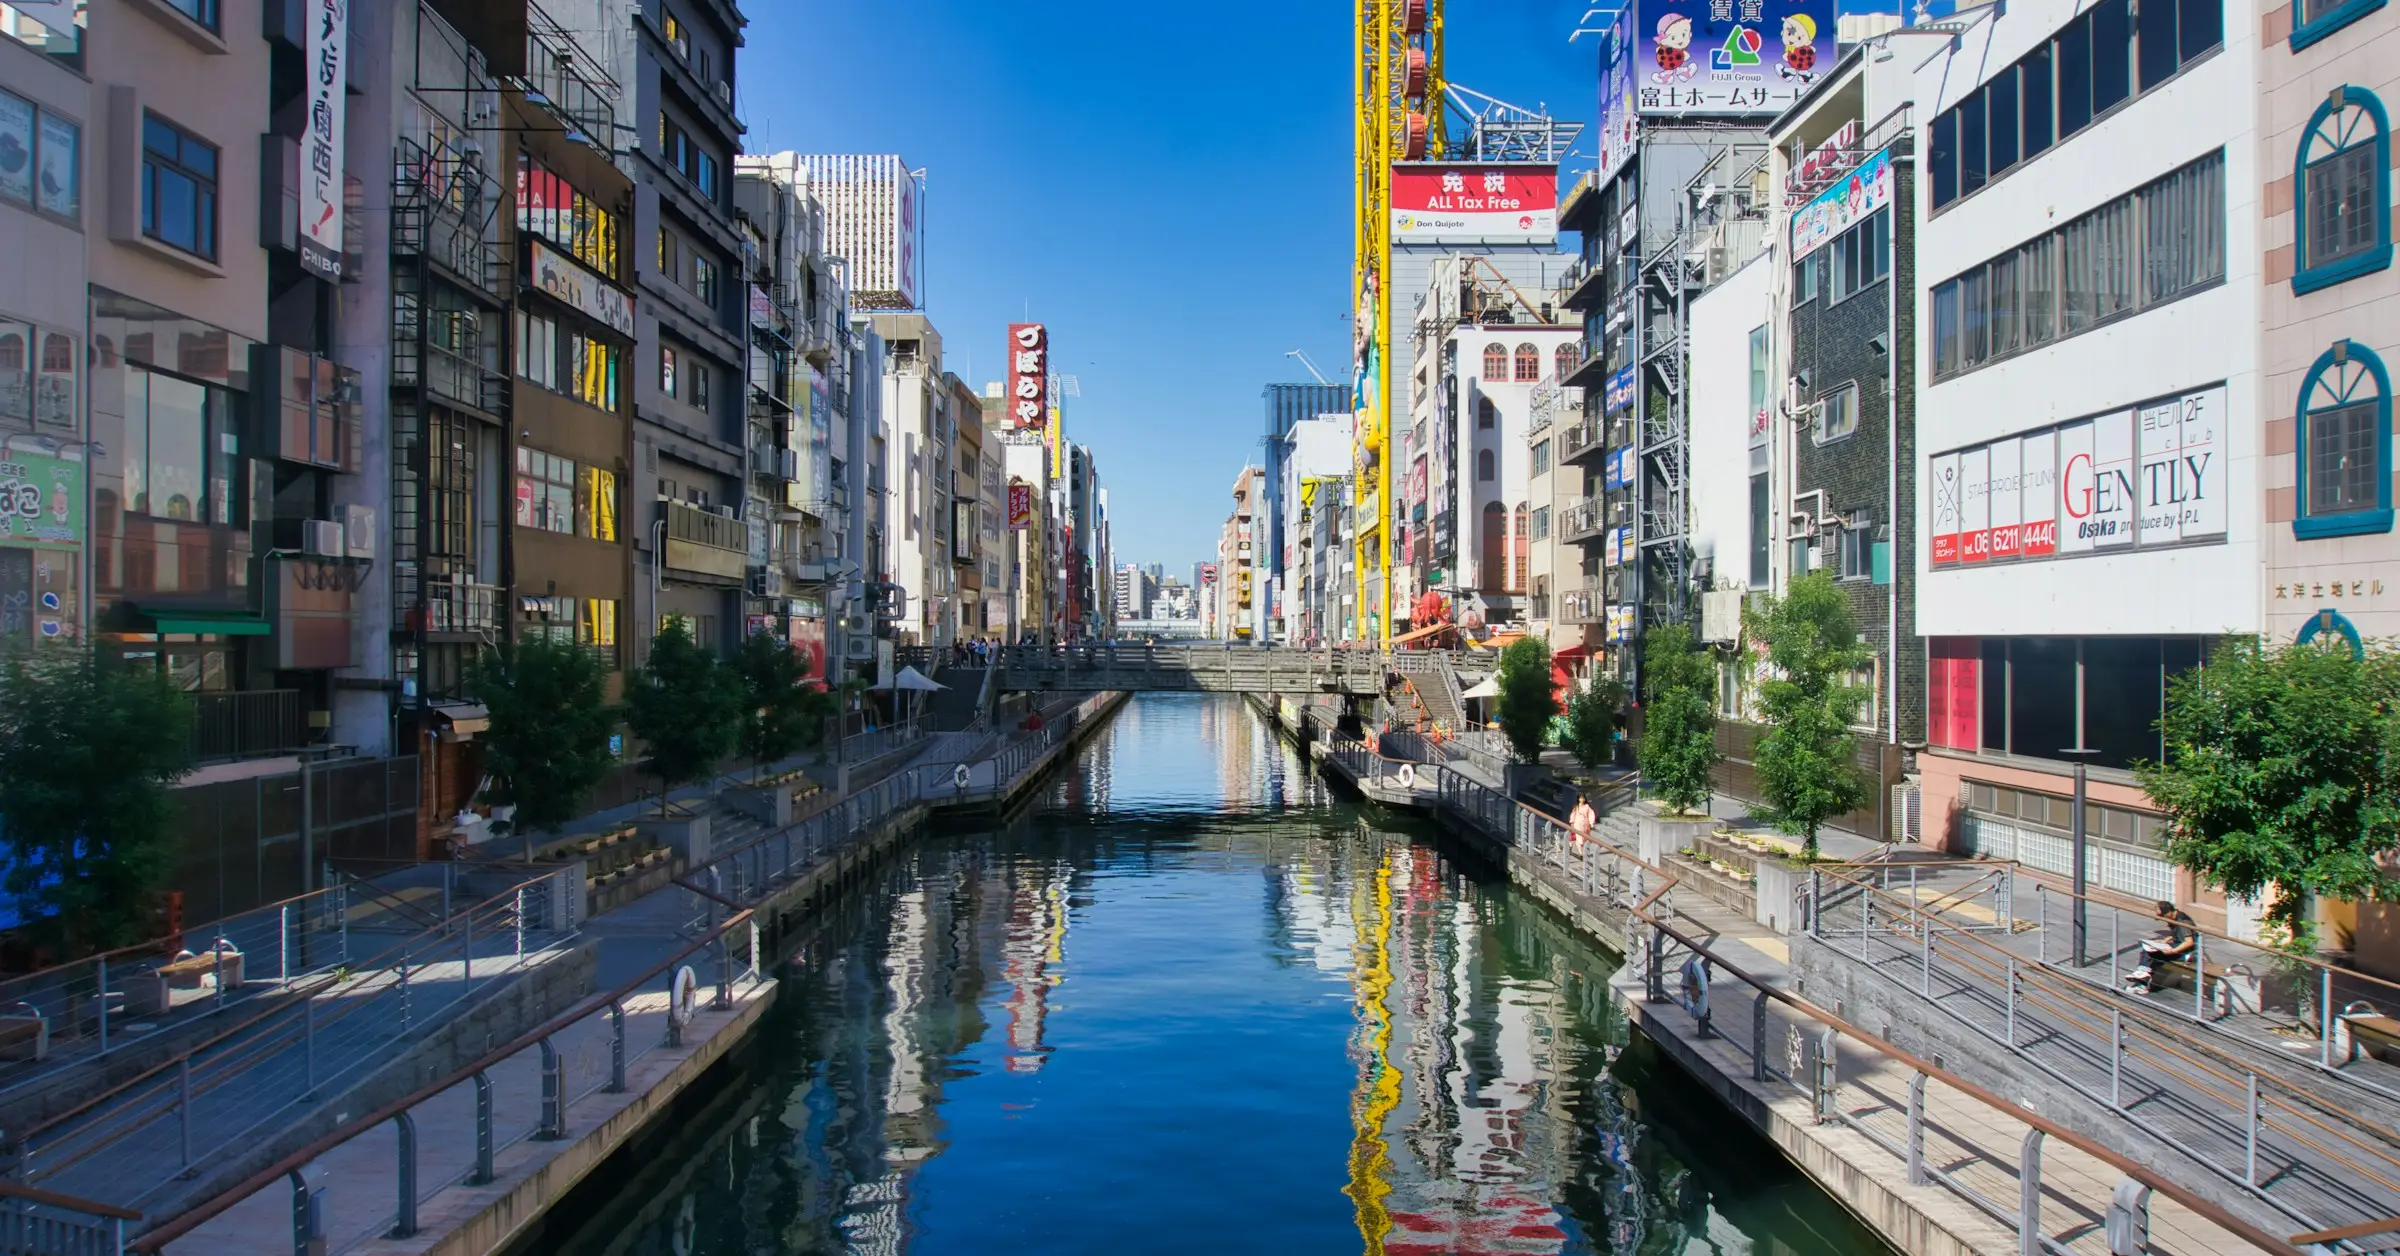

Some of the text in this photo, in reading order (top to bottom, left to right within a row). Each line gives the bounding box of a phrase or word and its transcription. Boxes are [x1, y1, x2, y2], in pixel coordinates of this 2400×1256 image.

[1735, 73, 1762, 82] Group
[1441, 170, 1506, 193] 免税
[1427, 195, 1520, 209] ALL Tax Free
[1416, 220, 1465, 229] Don Quijote
[302, 246, 341, 275] CHIBO
[2185, 396, 2205, 423] 2F
[2063, 451, 2212, 519] GENTLY
[1010, 492, 1019, 519] ドラッグ
[1019, 487, 1028, 513] ツルハ
[1974, 532, 1989, 554] 06
[1993, 529, 2019, 552] 6211
[2024, 523, 2056, 547] 4440
[2078, 519, 2116, 539] Osaka
[2163, 512, 2176, 529] by
